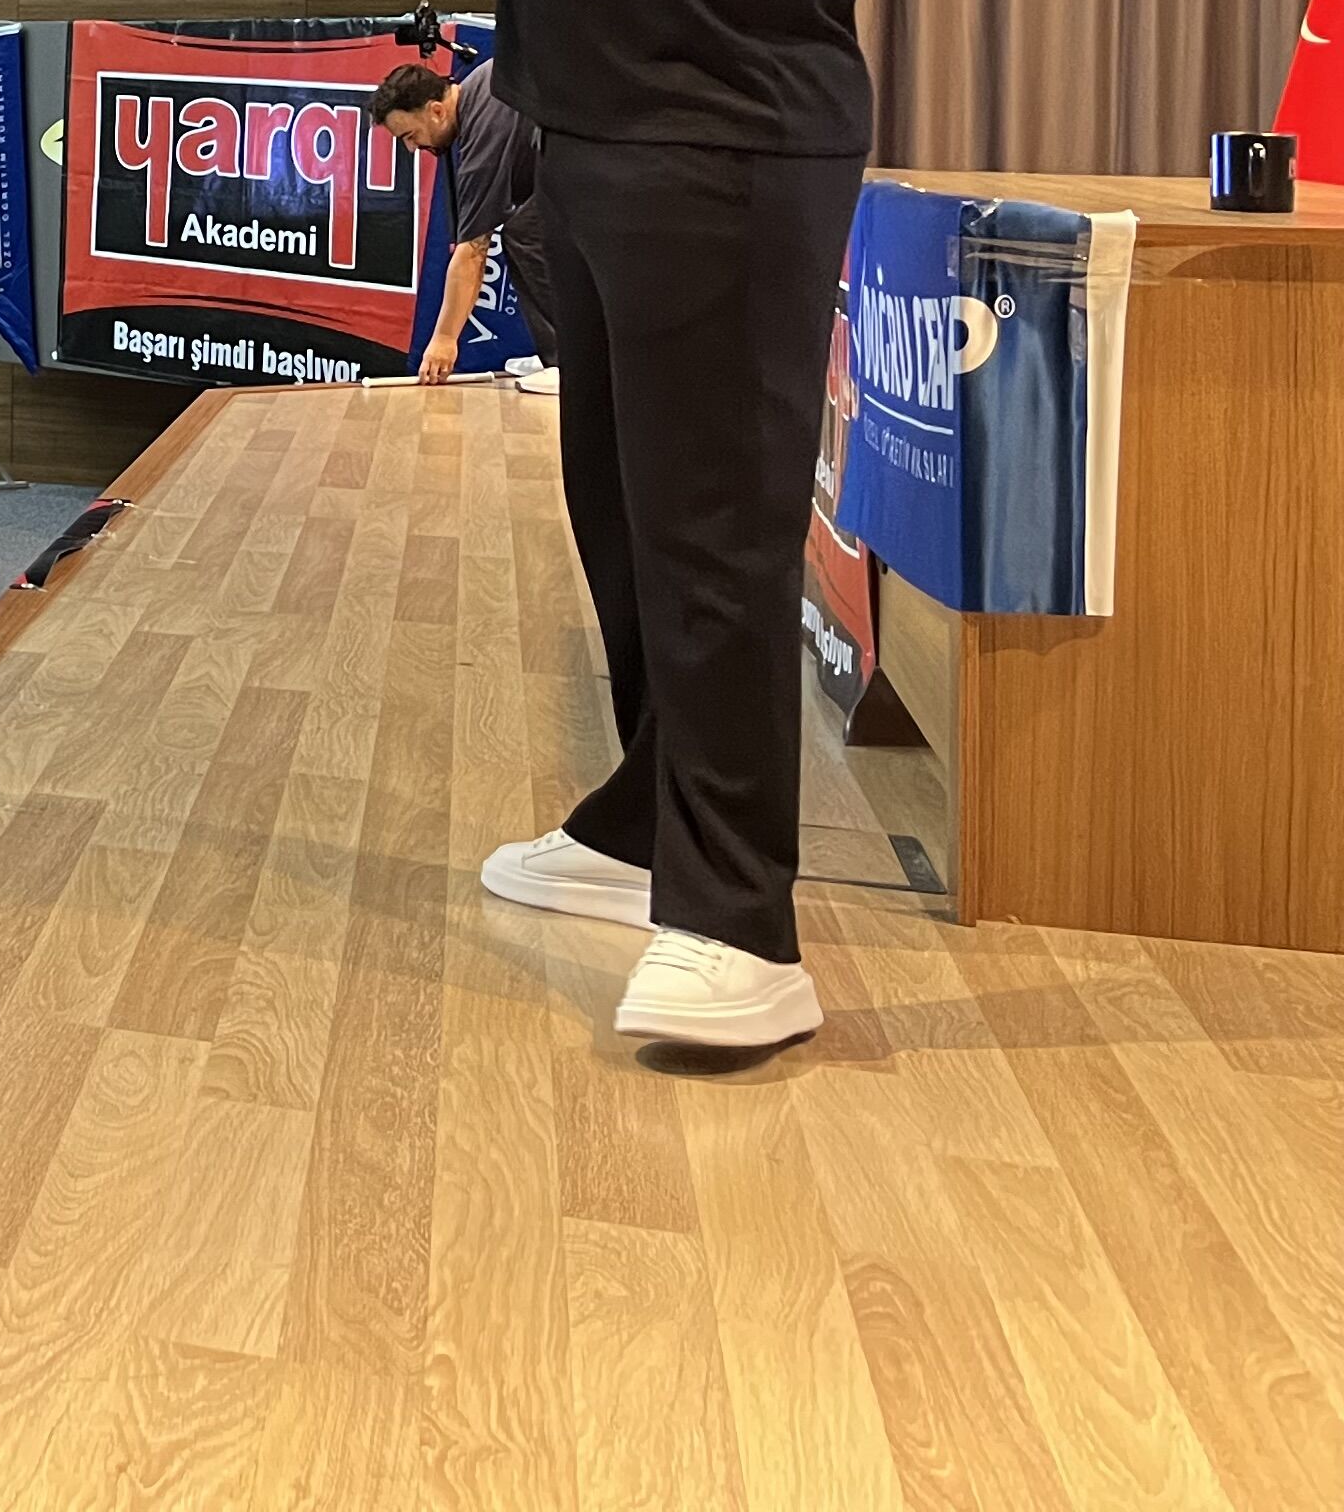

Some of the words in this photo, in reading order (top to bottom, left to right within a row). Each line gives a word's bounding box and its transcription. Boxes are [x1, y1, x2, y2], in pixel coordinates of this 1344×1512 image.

[180, 212, 318, 257] Akademi
[113, 320, 185, 363] Başarı
[190, 333, 255, 371] şimdi
[261, 342, 362, 386] başlıyor
